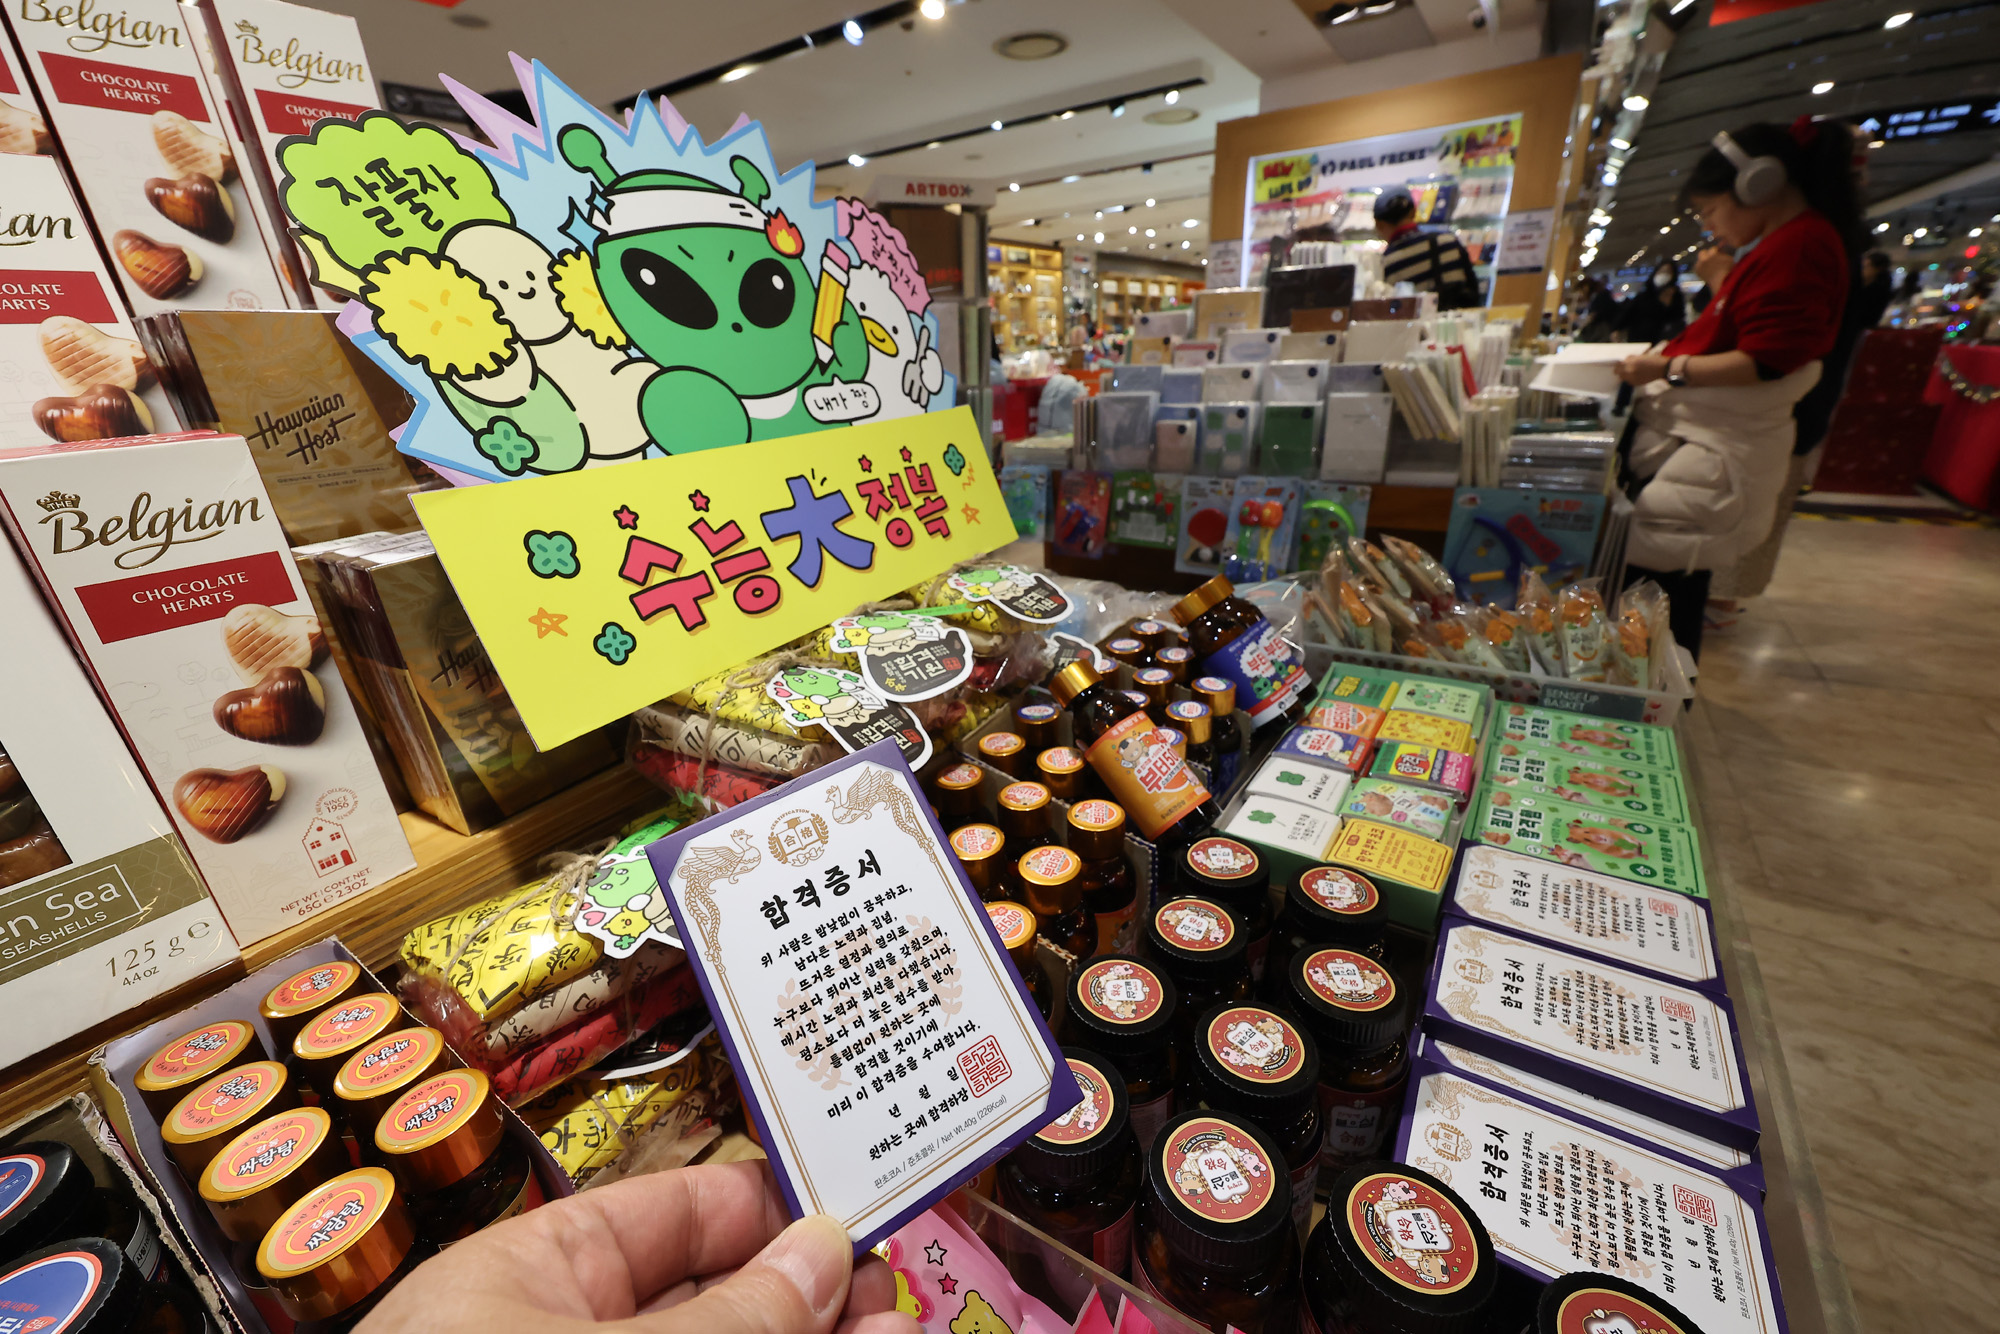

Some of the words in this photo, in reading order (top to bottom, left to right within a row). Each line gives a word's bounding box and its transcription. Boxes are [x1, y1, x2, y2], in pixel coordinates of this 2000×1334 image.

[21, 0, 185, 52] Belgian
[235, 33, 365, 89] Belgian
[79, 70, 172, 94] CHOCOLATE
[103, 87, 161, 105] HEARTS
[315, 157, 460, 238] 잘풀자
[0, 283, 65, 296] OLATE
[0, 299, 51, 310] ARTS
[814, 392, 848, 412] 내가
[850, 387, 868, 410] 짱
[247, 393, 346, 450] Hawaiian
[286, 412, 357, 465] Host
[49, 499, 73, 510] THE
[38, 491, 264, 570] Belgian
[132, 571, 249, 604] CHOCOLATE
[161, 589, 235, 615] HEARTS
[894, 648, 936, 672] 합격
[903, 660, 947, 681] 기원
[860, 719, 897, 743] 합격
[324, 795, 348, 806] SINCE
[326, 802, 349, 813] 1956
[783, 826, 812, 847] 合格
[1041, 849, 1065, 878] 부터500
[45, 882, 121, 921] Sea
[281, 900, 299, 913] NET
[302, 892, 319, 903] WT.
[324, 878, 352, 893] CONT.
[353, 868, 372, 879] NET.
[759, 848, 881, 929] 합격증서
[1512, 870, 1530, 907] 합격증서
[298, 900, 322, 916] 65G
[997, 910, 1023, 934] 터500
[2, 911, 107, 959] SEASHELLS
[761, 952, 772, 967] 위
[778, 933, 812, 957] 사람은
[815, 906, 859, 938] 밤낮없이
[863, 884, 912, 912] 공부하고,
[794, 945, 829, 971] 남다른
[834, 924, 867, 949] 노력과
[870, 910, 897, 929] 집념,
[106, 939, 155, 977] 125
[169, 935, 185, 957] g
[799, 964, 835, 991] 뜨거운
[838, 943, 872, 969] 열정과
[875, 925, 909, 948] 열의로
[123, 970, 142, 987] 4.4
[143, 966, 160, 978] oz
[773, 993, 822, 1028] 누구보다
[826, 971, 861, 999] 뛰어난
[864, 952, 896, 977] 실력을
[899, 925, 947, 958] 갖췄으며,
[1339, 975, 1360, 990] 合格
[1500, 958, 1524, 1009] 합격증서
[780, 1019, 818, 1046] 매시간
[822, 996, 858, 1024] 노력과
[861, 975, 894, 1001] 최선을
[897, 943, 955, 979] 다했습니다.
[799, 1024, 848, 1061] 평소보다
[852, 1015, 864, 1028] 더
[868, 1000, 891, 1022] 높은
[894, 978, 929, 1005] 점수를
[931, 963, 953, 984] 받아
[829, 1032, 876, 1068] 틀림없이
[879, 1012, 913, 1038] 원하는
[917, 993, 941, 1016] 곳에
[854, 1048, 890, 1078] 합격할
[893, 1018, 938, 1055] 것이기에
[961, 1040, 999, 1074] 합격
[1248, 1038, 1271, 1054] 合格
[827, 1095, 851, 1117] 미리
[856, 1085, 868, 1100] 이
[871, 1056, 918, 1092] 합격증을
[922, 1019, 980, 1060] 수여합니다.
[416, 1096, 438, 1112] 감동
[888, 1103, 901, 1117] 년
[918, 1084, 930, 1099] 월
[946, 1066, 959, 1081] 일
[403, 1096, 457, 1133] 싸랑탕
[869, 1133, 902, 1160] 원하는
[904, 1114, 927, 1138] 곳에
[927, 1087, 968, 1121] 합격하장
[237, 1139, 297, 1176] 싸랑탕
[256, 1138, 280, 1154] 감동
[1522, 1131, 1533, 1159] 공부하고,
[1537, 1151, 1548, 1166] 집념,
[1205, 1155, 1228, 1171] 合格
[1479, 1123, 1509, 1201] 합격증서
[1520, 1160, 1532, 1189] 밤낮없이
[1553, 1154, 1564, 1175] 열의로
[1585, 1149, 1597, 1185] 다했습니다.
[1537, 1167, 1548, 1191] 노력과
[1553, 1176, 1565, 1199] 열정과
[1519, 1192, 1531, 1216] 사람은
[1536, 1192, 1548, 1216] 남다른
[1586, 1187, 1598, 1210] 최선을
[1637, 1195, 1652, 1229] 것이기에
[305, 1199, 364, 1251] 싸랑탕
[310, 1210, 335, 1230] 감동
[1368, 1223, 1376, 1234] LUCK
[1395, 1216, 1415, 1241] 合格
[1519, 1217, 1530, 1227] 위
[1553, 1202, 1564, 1228] 뜨거운
[1587, 1211, 1599, 1238] 노력과
[1588, 1239, 1600, 1267] 매시간
[1640, 1230, 1655, 1257] 합격할
